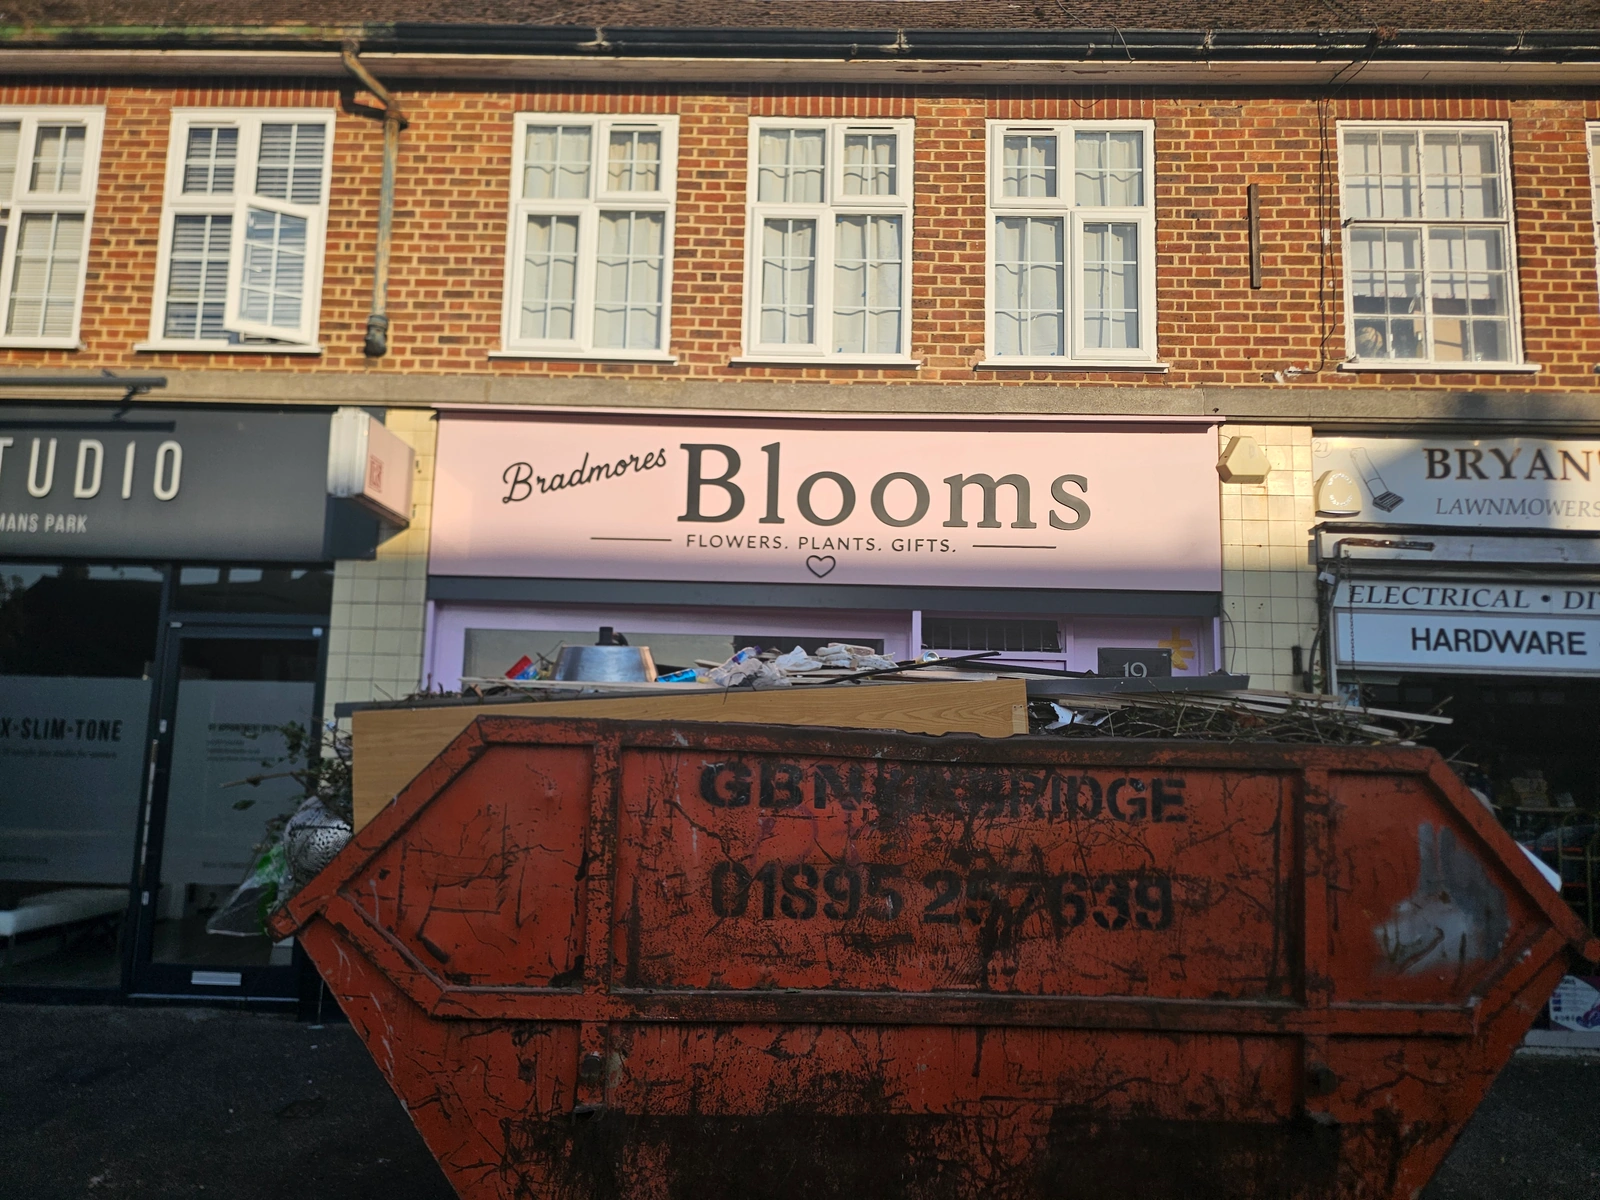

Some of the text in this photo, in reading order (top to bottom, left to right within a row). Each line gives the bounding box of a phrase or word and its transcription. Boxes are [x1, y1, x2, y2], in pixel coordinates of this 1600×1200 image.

[1314, 441, 1329, 453] 21
[501, 447, 667, 504] Bradmores
[1422, 448, 1600, 481] BRYAN
[677, 441, 1092, 531] Blooms
[1436, 498, 1600, 518] LAWNMOWERS
[44, 513, 88, 534] PARK
[686, 534, 957, 553] FLOWERS. PLANTS. GIFTS.
[1348, 585, 1600, 610] ELECTRICAL DI
[1411, 627, 1588, 656] HARDWARE
[1122, 661, 1148, 678] 19
[711, 860, 904, 922] 01895
